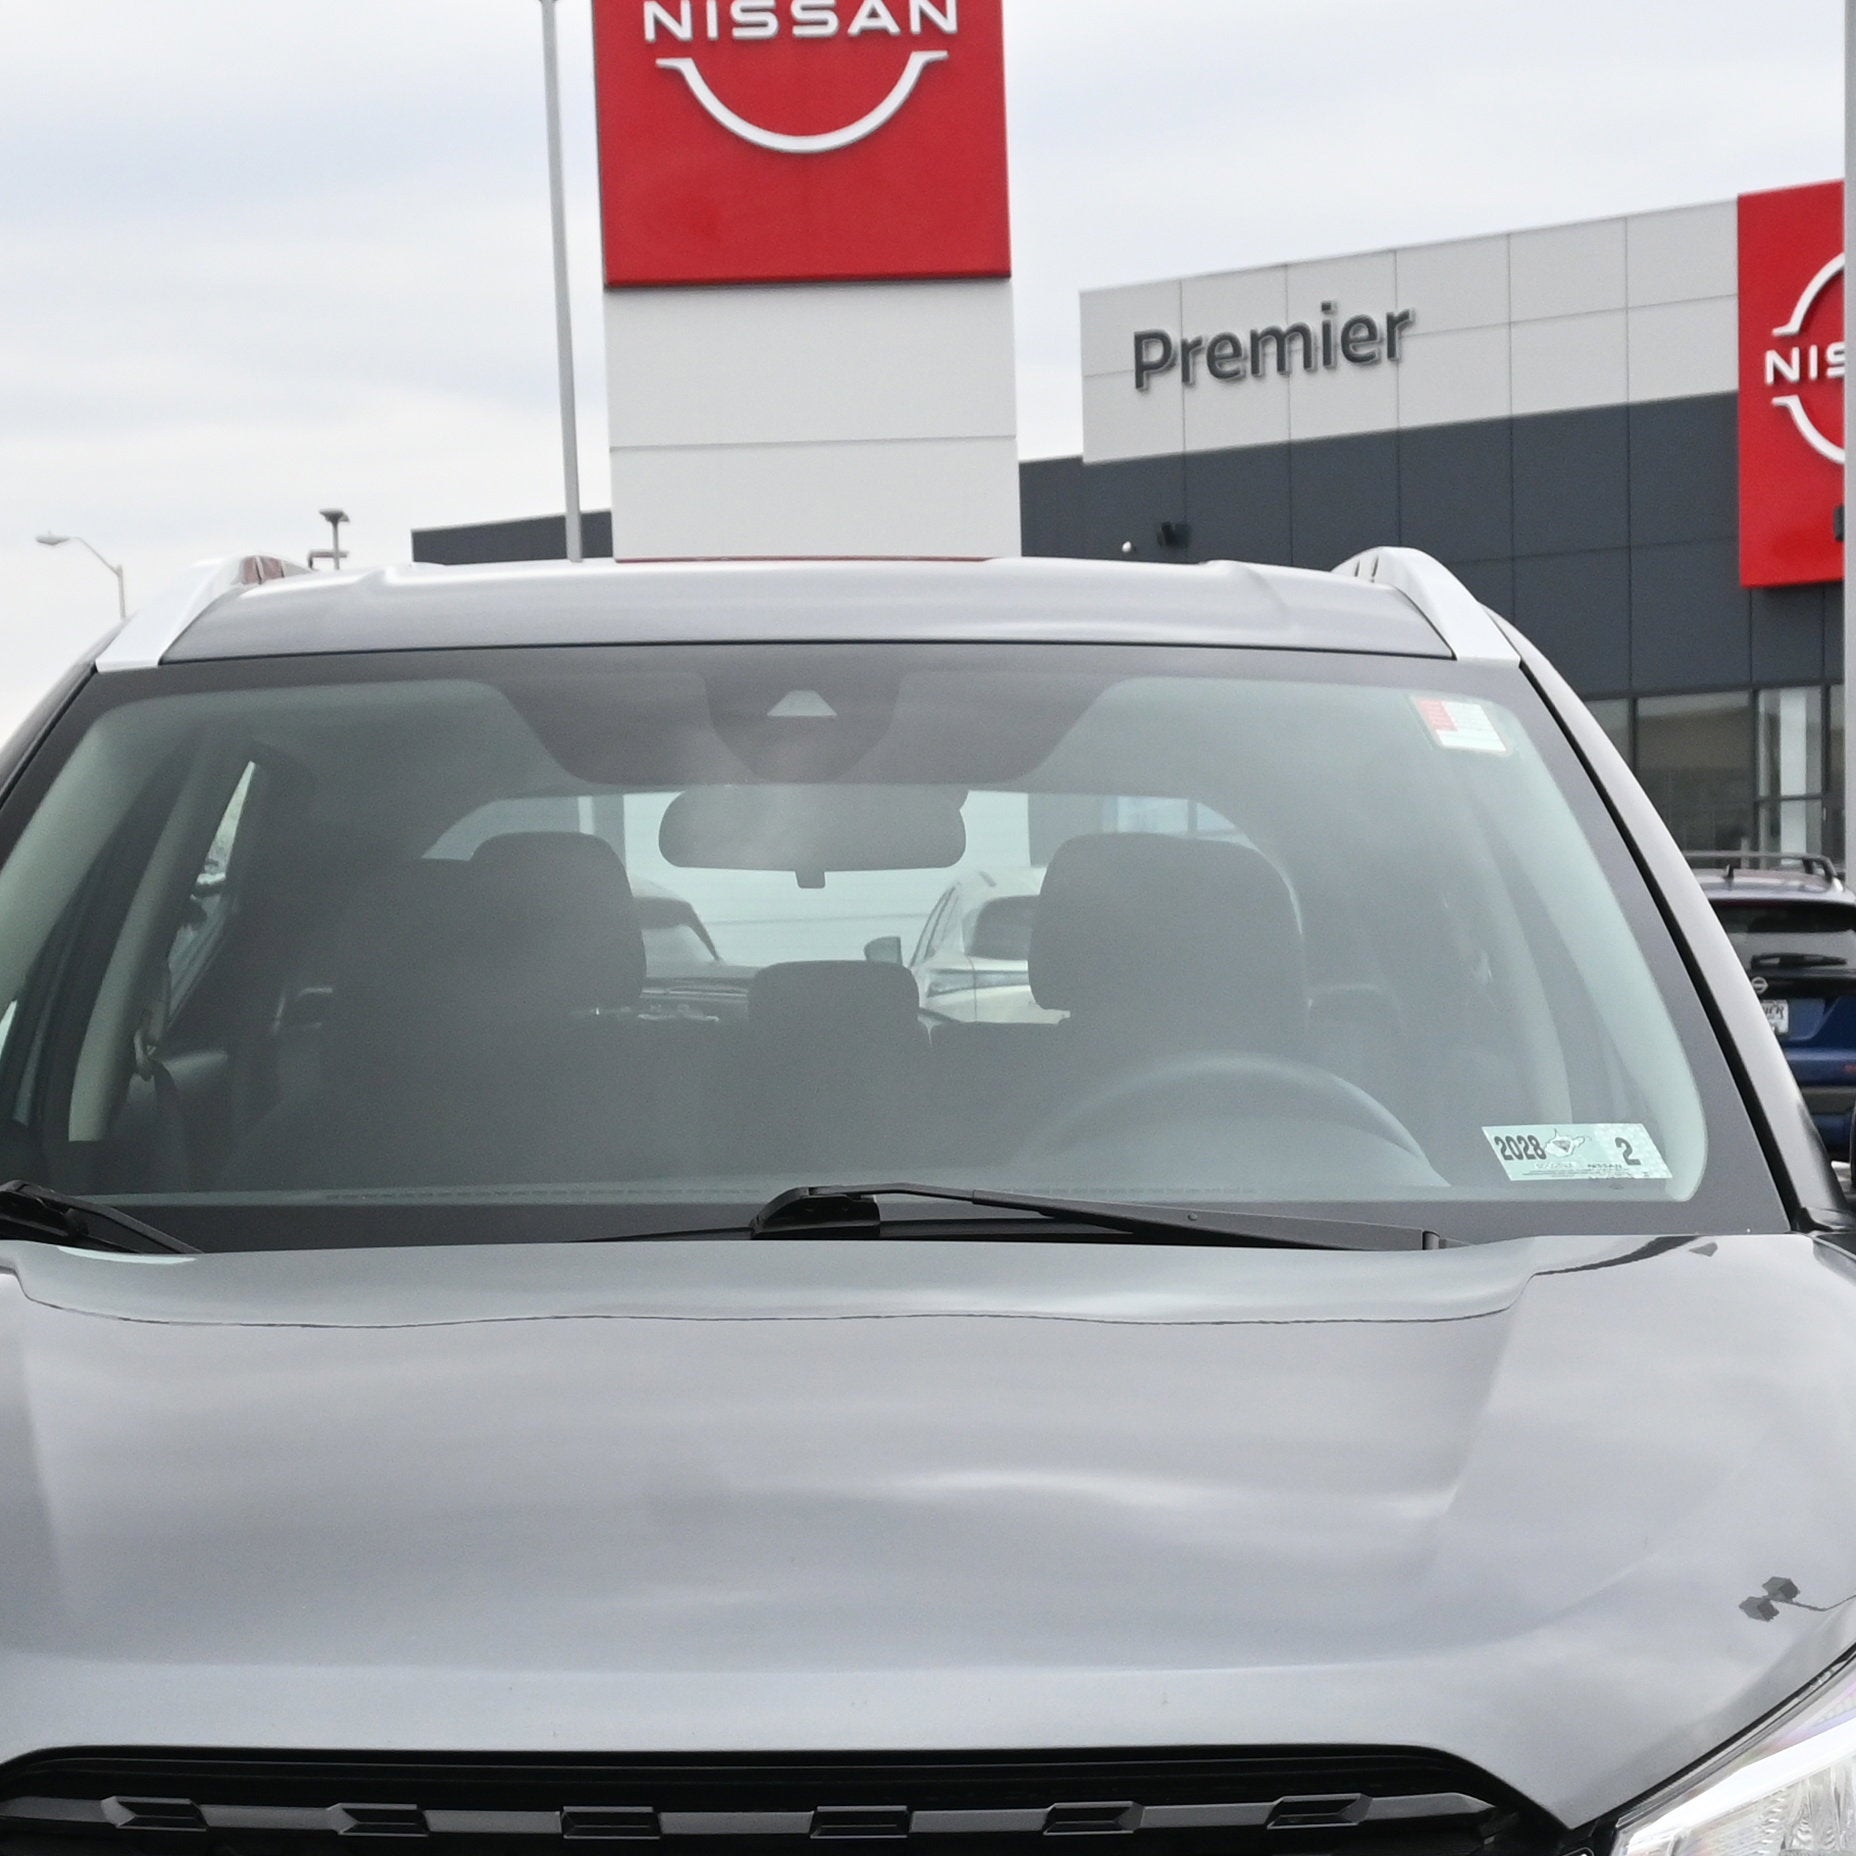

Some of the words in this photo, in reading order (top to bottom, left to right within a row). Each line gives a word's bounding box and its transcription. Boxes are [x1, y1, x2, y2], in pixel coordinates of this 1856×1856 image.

[644, 0, 958, 42] NISSAN
[1133, 300, 1412, 391] Premier
[1494, 1134, 1547, 1161] 2028
[1614, 1137, 1642, 1166] 2
